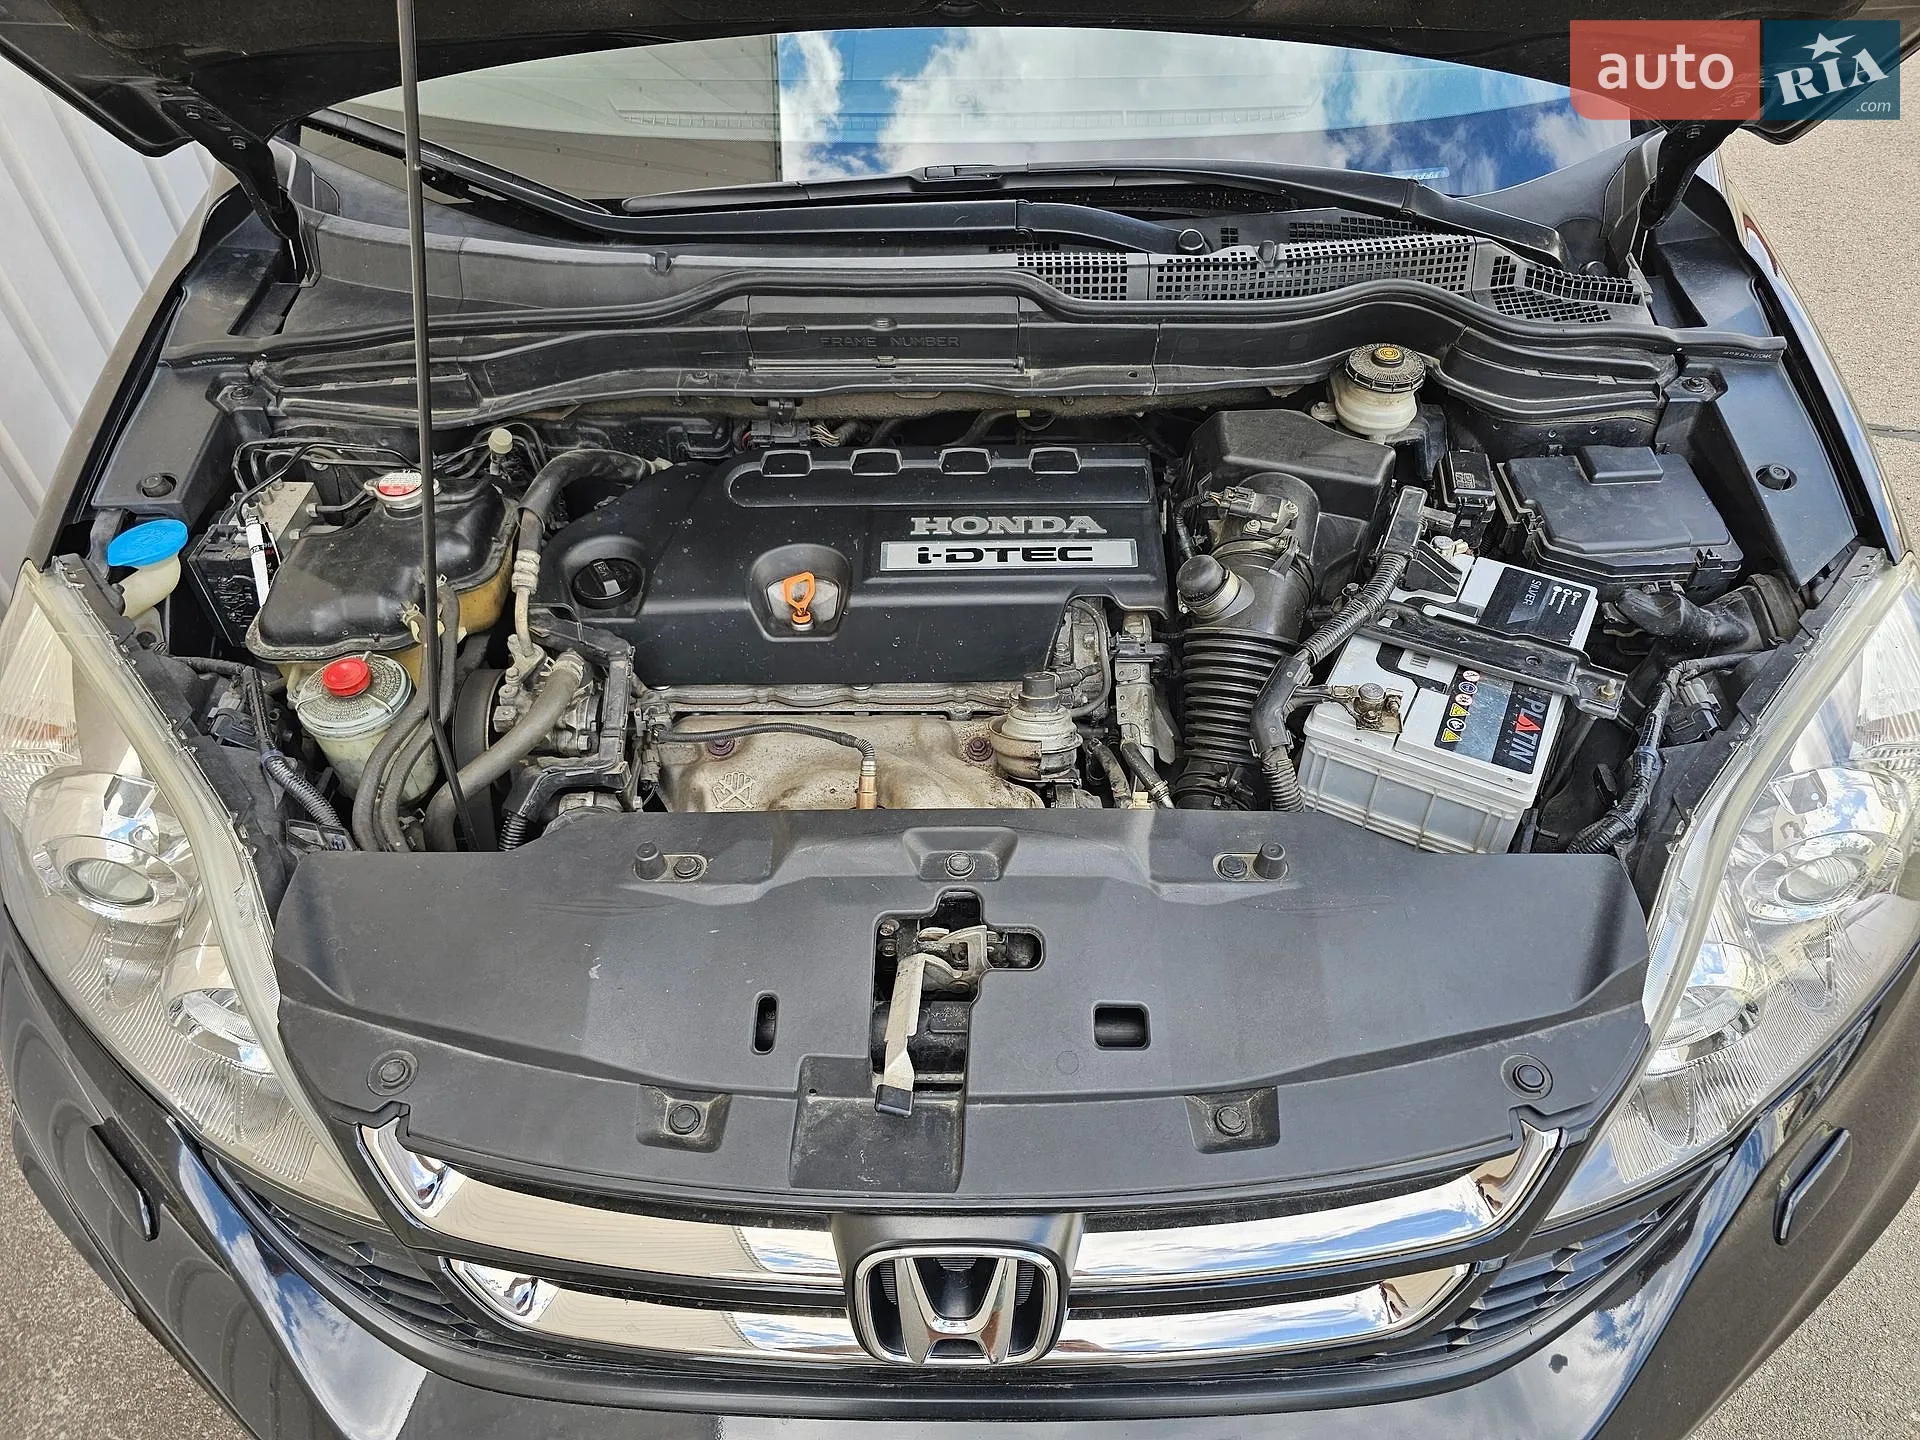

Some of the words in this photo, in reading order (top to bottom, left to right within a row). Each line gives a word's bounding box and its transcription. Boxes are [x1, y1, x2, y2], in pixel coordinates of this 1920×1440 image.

[819, 336, 877, 347] FRAME
[889, 336, 961, 347] NUMBER
[910, 515, 1108, 536] HONDA
[917, 546, 1094, 565] i-DTEC
[1522, 579, 1542, 606] SILVER
